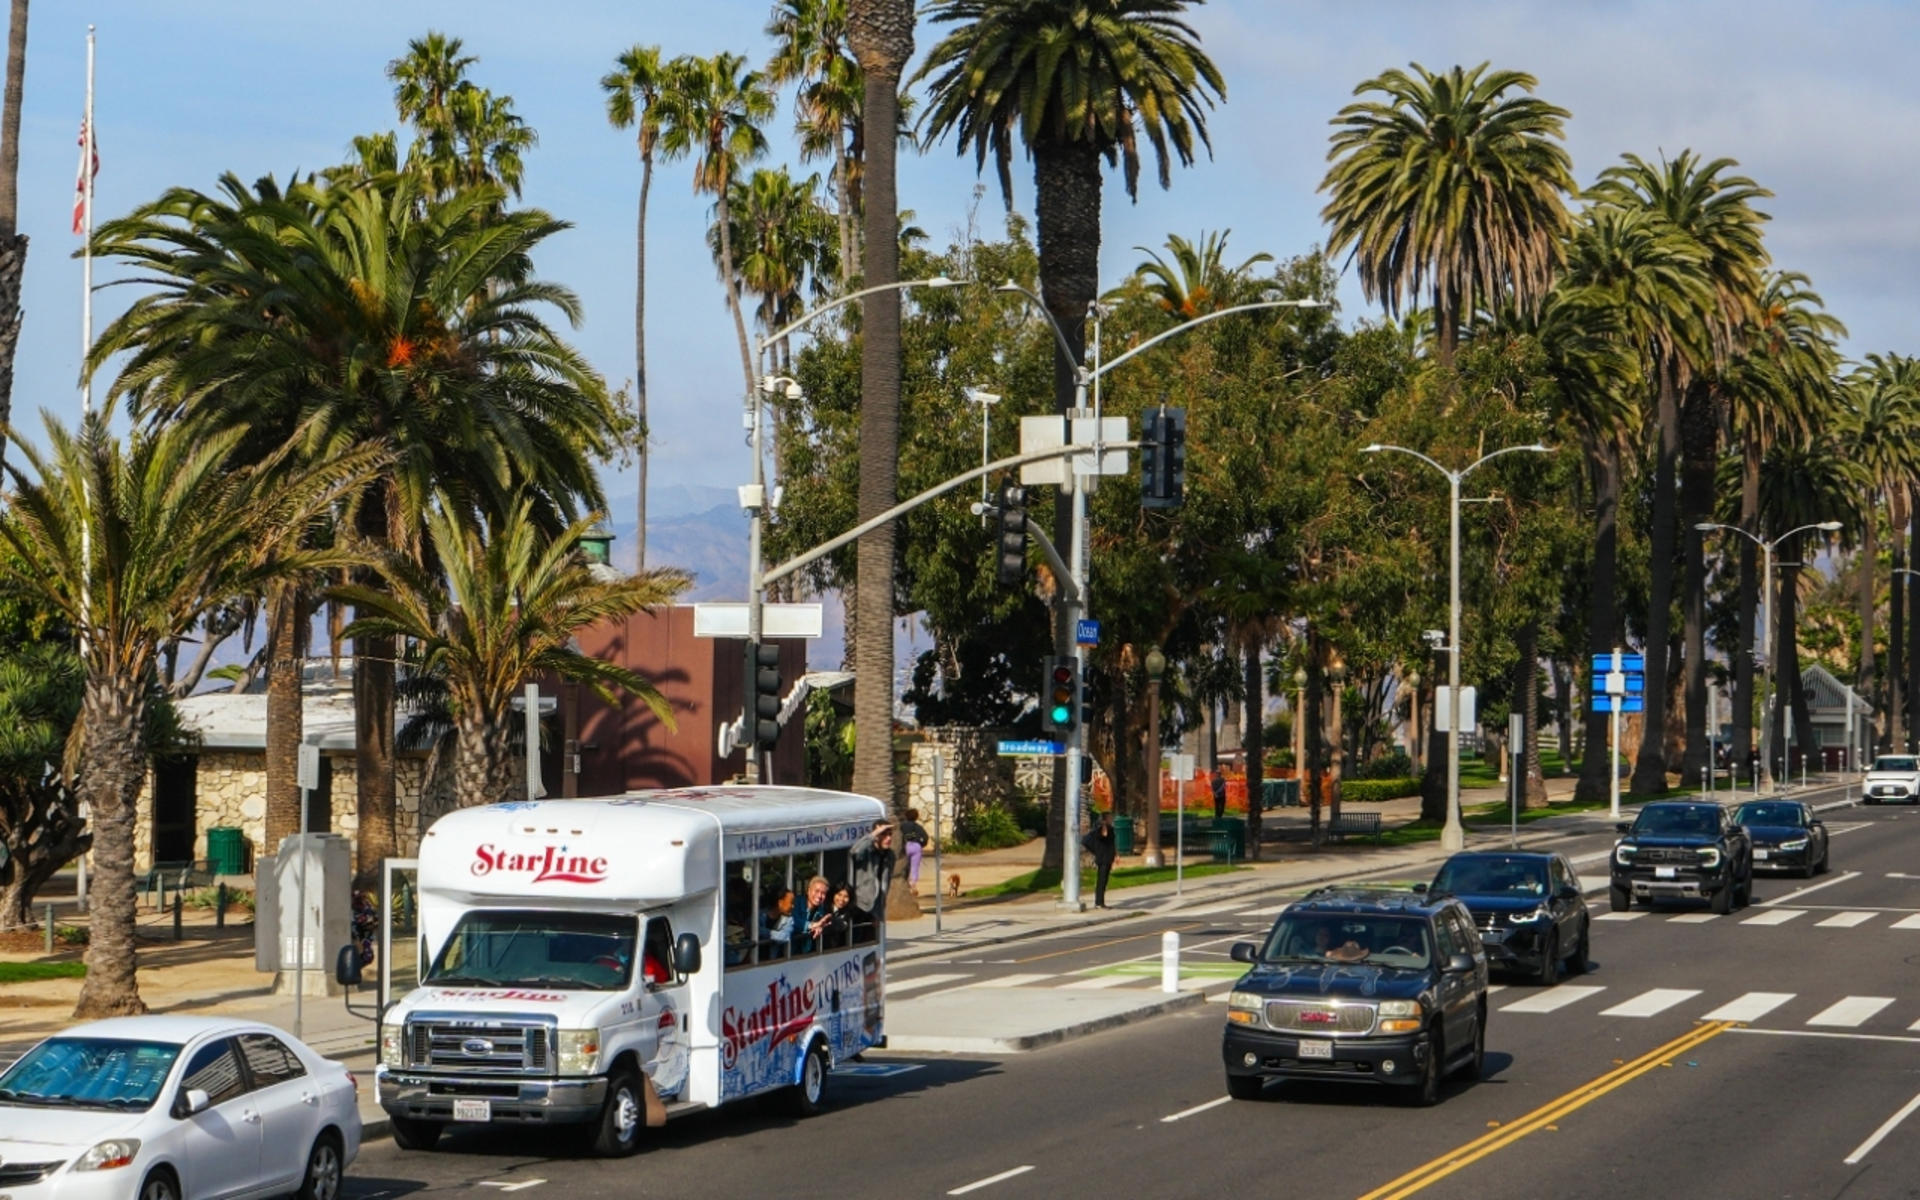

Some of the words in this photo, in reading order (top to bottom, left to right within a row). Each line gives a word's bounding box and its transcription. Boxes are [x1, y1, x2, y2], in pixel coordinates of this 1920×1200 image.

[1078, 623, 1097, 638] Ocean
[999, 741, 1049, 753] Broadway
[816, 954, 861, 1010] TOURS
